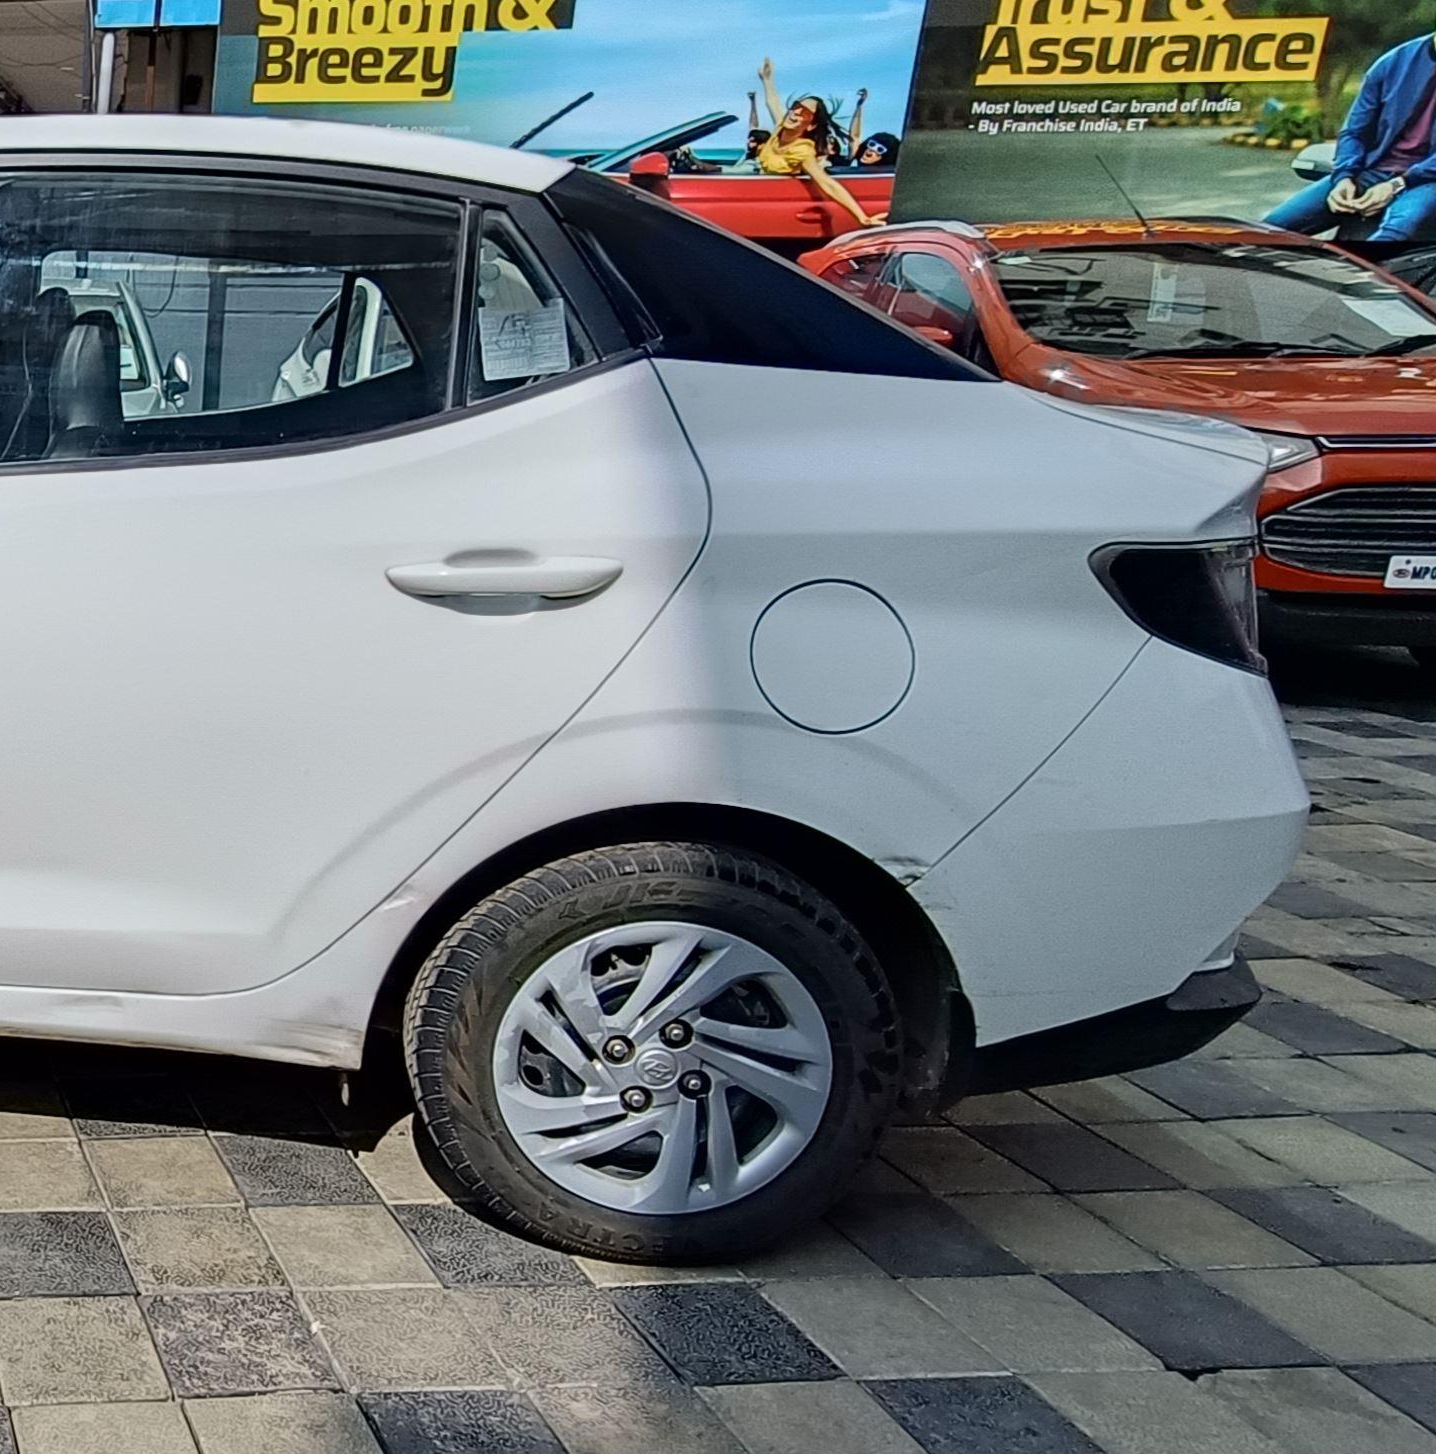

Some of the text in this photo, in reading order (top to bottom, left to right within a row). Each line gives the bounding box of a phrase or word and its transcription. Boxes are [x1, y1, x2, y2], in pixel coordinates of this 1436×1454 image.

[258, 0, 557, 35] Smooth &
[255, 36, 457, 97] Breezy
[978, 26, 1315, 75] Assurance
[971, 97, 1242, 114] Most loved Used Car brand of India
[977, 119, 999, 135] By
[1002, 118, 1076, 132] Franchise
[1079, 118, 1122, 133] India,
[1125, 118, 1149, 131] ET
